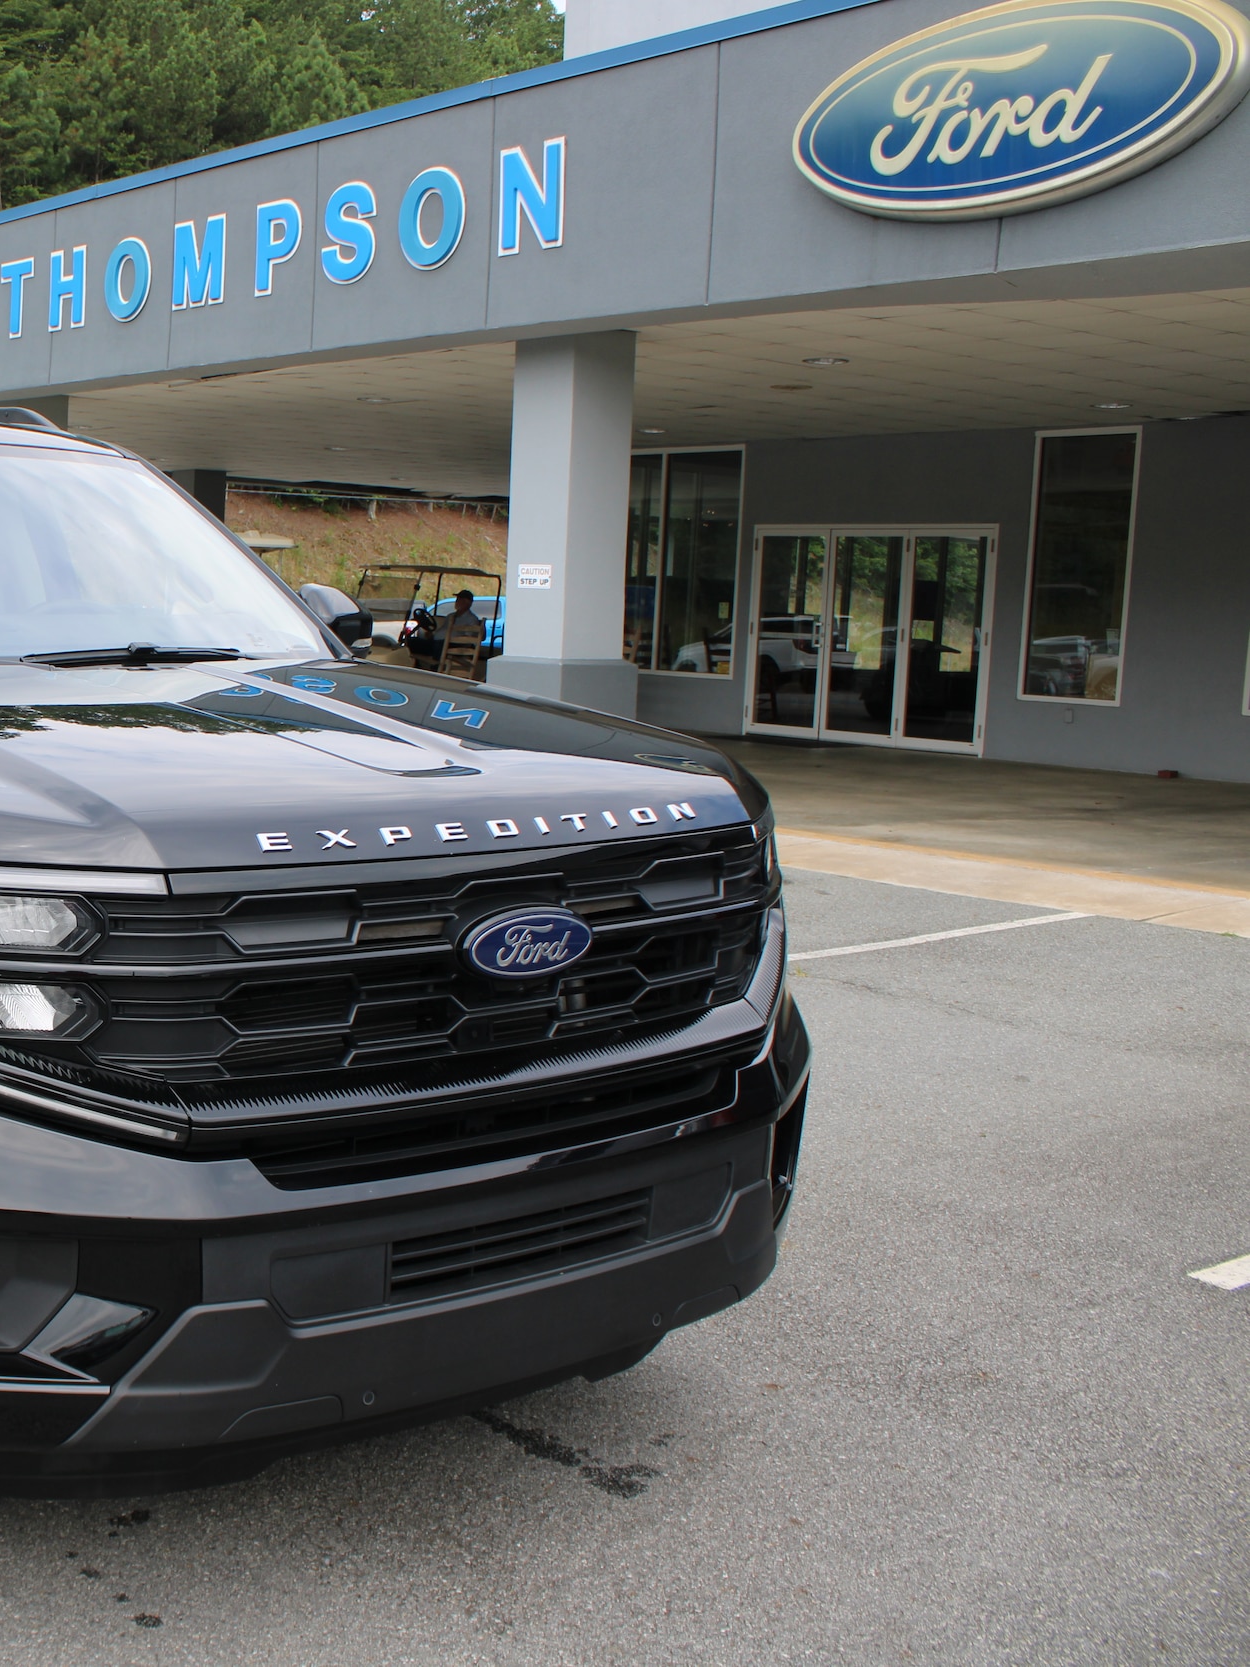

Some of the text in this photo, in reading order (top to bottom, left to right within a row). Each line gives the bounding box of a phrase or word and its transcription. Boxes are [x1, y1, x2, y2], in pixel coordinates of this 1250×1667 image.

[870, 44, 1112, 176] Ford
[0, 134, 566, 339] THOMPSON
[519, 577, 549, 586] STEP UP
[520, 567, 550, 576] CAUTION
[255, 801, 698, 854] EXPEDITION
[496, 923, 571, 967] Ford
